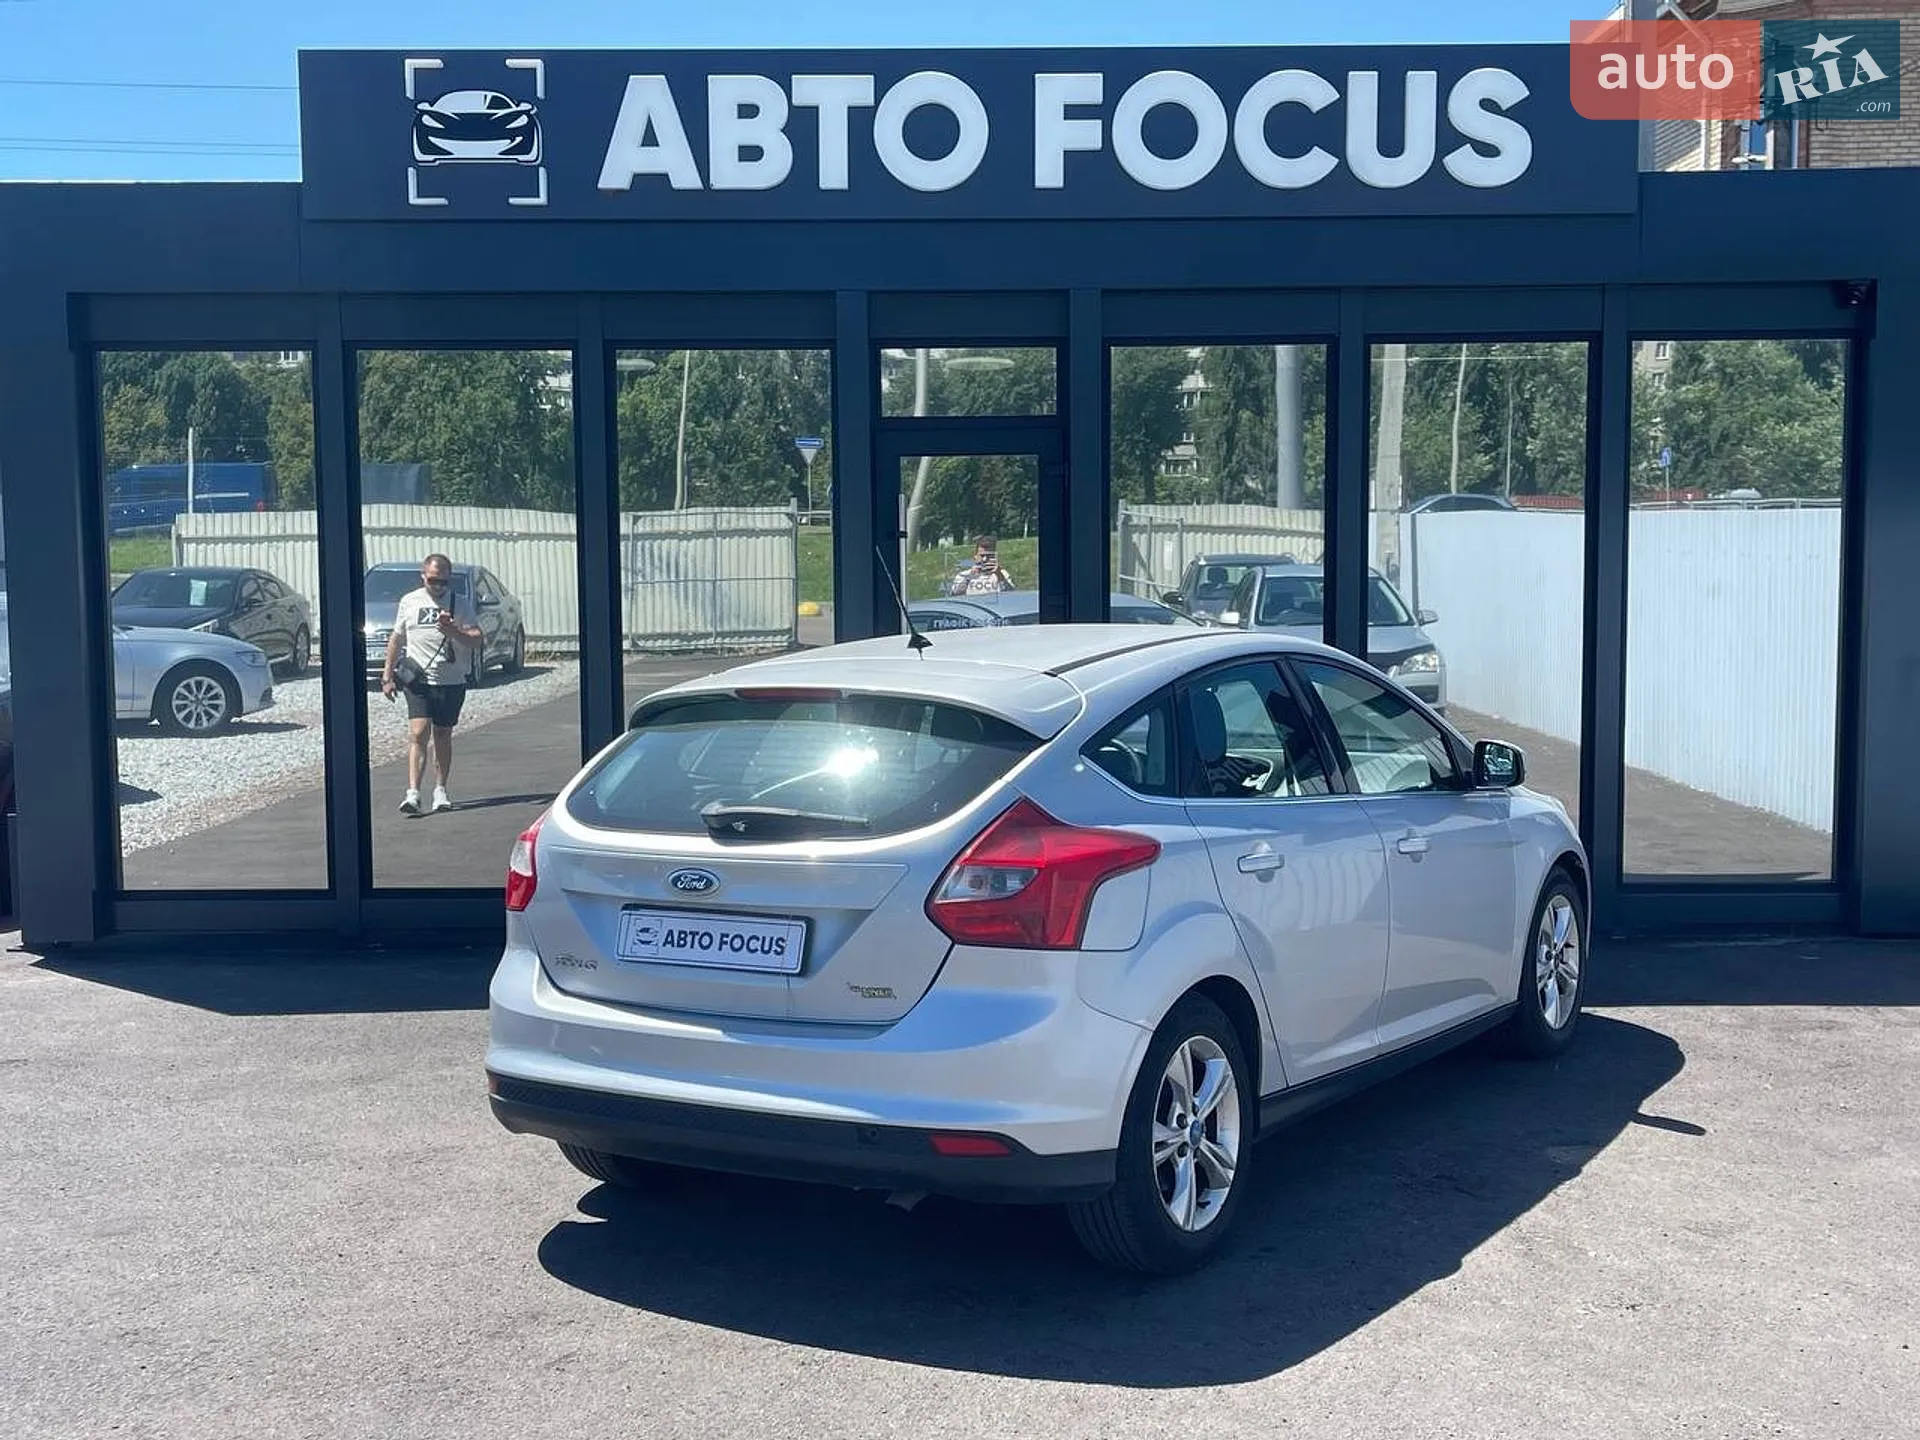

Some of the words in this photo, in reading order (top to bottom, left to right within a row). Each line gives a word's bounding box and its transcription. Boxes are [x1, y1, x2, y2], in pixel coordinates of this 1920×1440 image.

[597, 71, 989, 192] АВТО
[1034, 67, 1533, 190] FOCUS
[676, 874, 708, 891] Ford
[661, 928, 714, 951] АВТО
[717, 932, 787, 957] FOCUS
